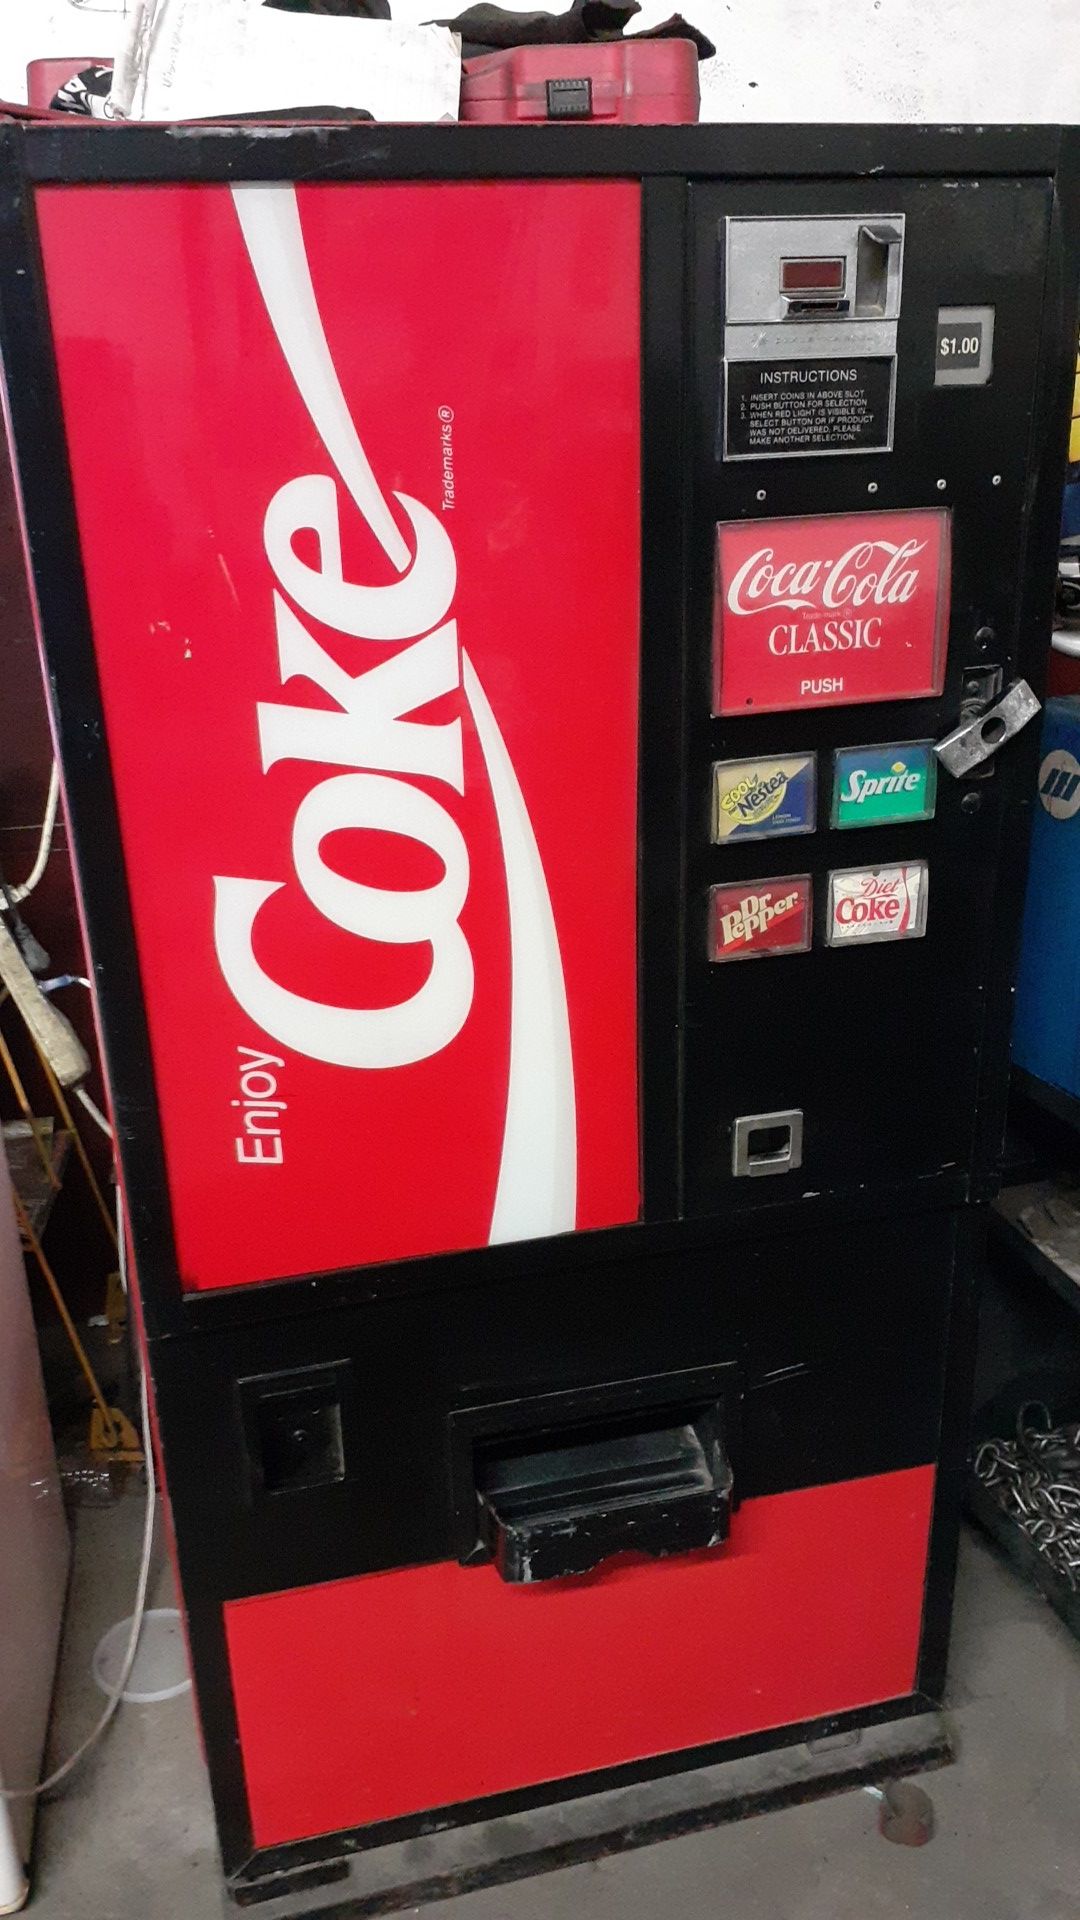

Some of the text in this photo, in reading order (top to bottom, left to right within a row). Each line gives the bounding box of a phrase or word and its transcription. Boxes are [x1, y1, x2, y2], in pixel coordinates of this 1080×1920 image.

[940, 337, 980, 356] $1.00
[760, 369, 858, 384] INSTRUCTIONS
[750, 392, 778, 401] INSERT
[780, 391, 805, 400] COINS
[807, 391, 815, 399] IN
[817, 390, 843, 399] ABOVE
[844, 389, 865, 398] SLOT
[750, 401, 772, 410] PUSH
[773, 400, 806, 409] BUTTON
[807, 400, 823, 408] FOR
[825, 398, 868, 407] SELECTION
[750, 410, 773, 419] WHEN
[775, 410, 791, 418] RED
[792, 408, 816, 417] LIGHT
[818, 408, 826, 416] IS
[827, 407, 855, 416] VISIBLE
[750, 415, 874, 428] SELECT BUTTON OR IF PRODUCT
[749, 436, 772, 445] MAKE
[773, 434, 810, 444] ANOTHER
[750, 428, 767, 437] WAS
[768, 427, 785, 436] NOT
[832, 424, 861, 433] PLEASE
[727, 538, 929, 616] Coca-Cola
[768, 616, 883, 657] CLASSIC
[800, 676, 844, 695] PUSH
[213, 474, 475, 1070] Coke
[720, 776, 756, 811] COOL
[737, 770, 790, 818] Nestea
[840, 766, 922, 804] Sprite
[861, 878, 900, 898] Diet
[740, 891, 774, 917] Dr
[835, 896, 900, 925] Coke
[720, 889, 800, 946] Pepper
[231, 1045, 288, 1166] Enjoy
